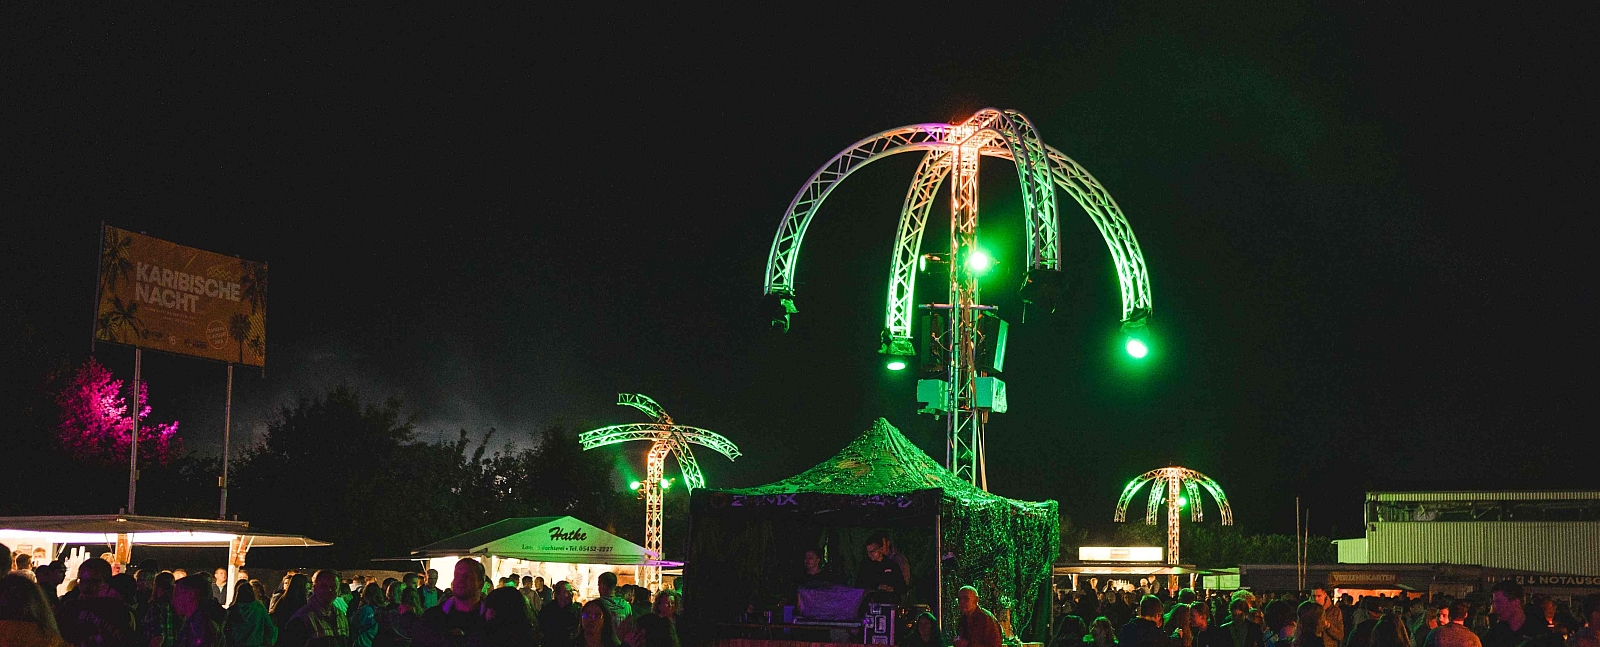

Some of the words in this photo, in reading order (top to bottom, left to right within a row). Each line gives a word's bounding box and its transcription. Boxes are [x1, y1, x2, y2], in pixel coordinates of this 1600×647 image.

[135, 262, 241, 302] KARIBISCHE
[135, 282, 200, 313] NACHT
[548, 526, 587, 541] Hatke
[1333, 573, 1396, 582] VERZEHRKARTEN
